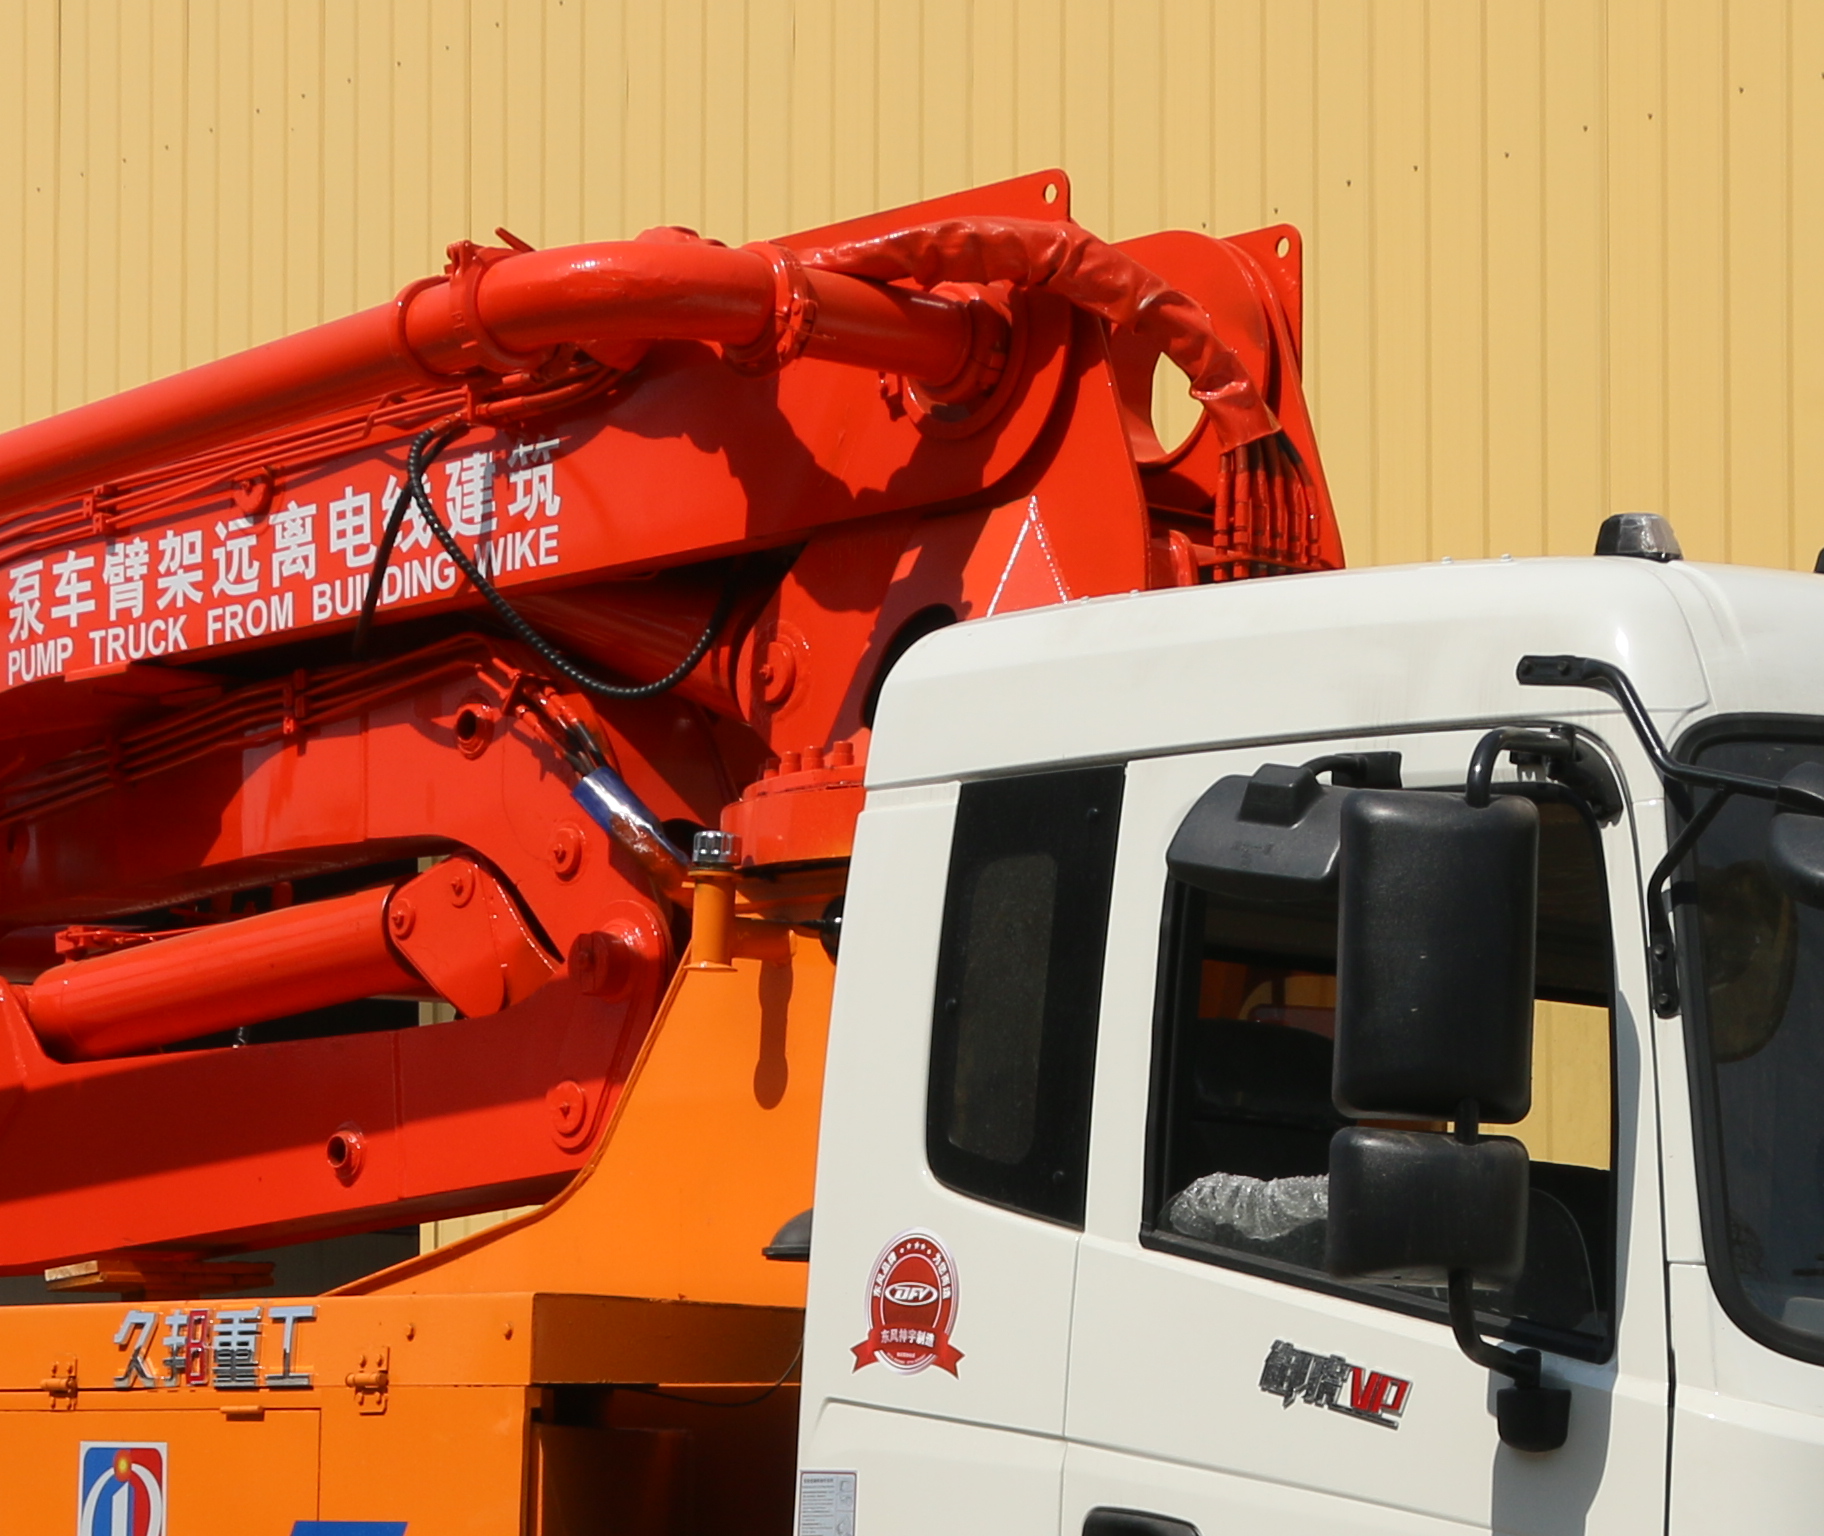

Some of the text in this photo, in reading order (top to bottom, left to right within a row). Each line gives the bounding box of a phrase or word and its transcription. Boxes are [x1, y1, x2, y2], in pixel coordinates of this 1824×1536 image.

[8, 436, 561, 640] 泵车臂架远离电线建筑
[8, 636, 73, 685] PUMP
[89, 614, 188, 665] TRUCK
[207, 591, 294, 645] FROM
[473, 525, 559, 579] WIKE
[114, 1305, 317, 1391] 久邦重工
